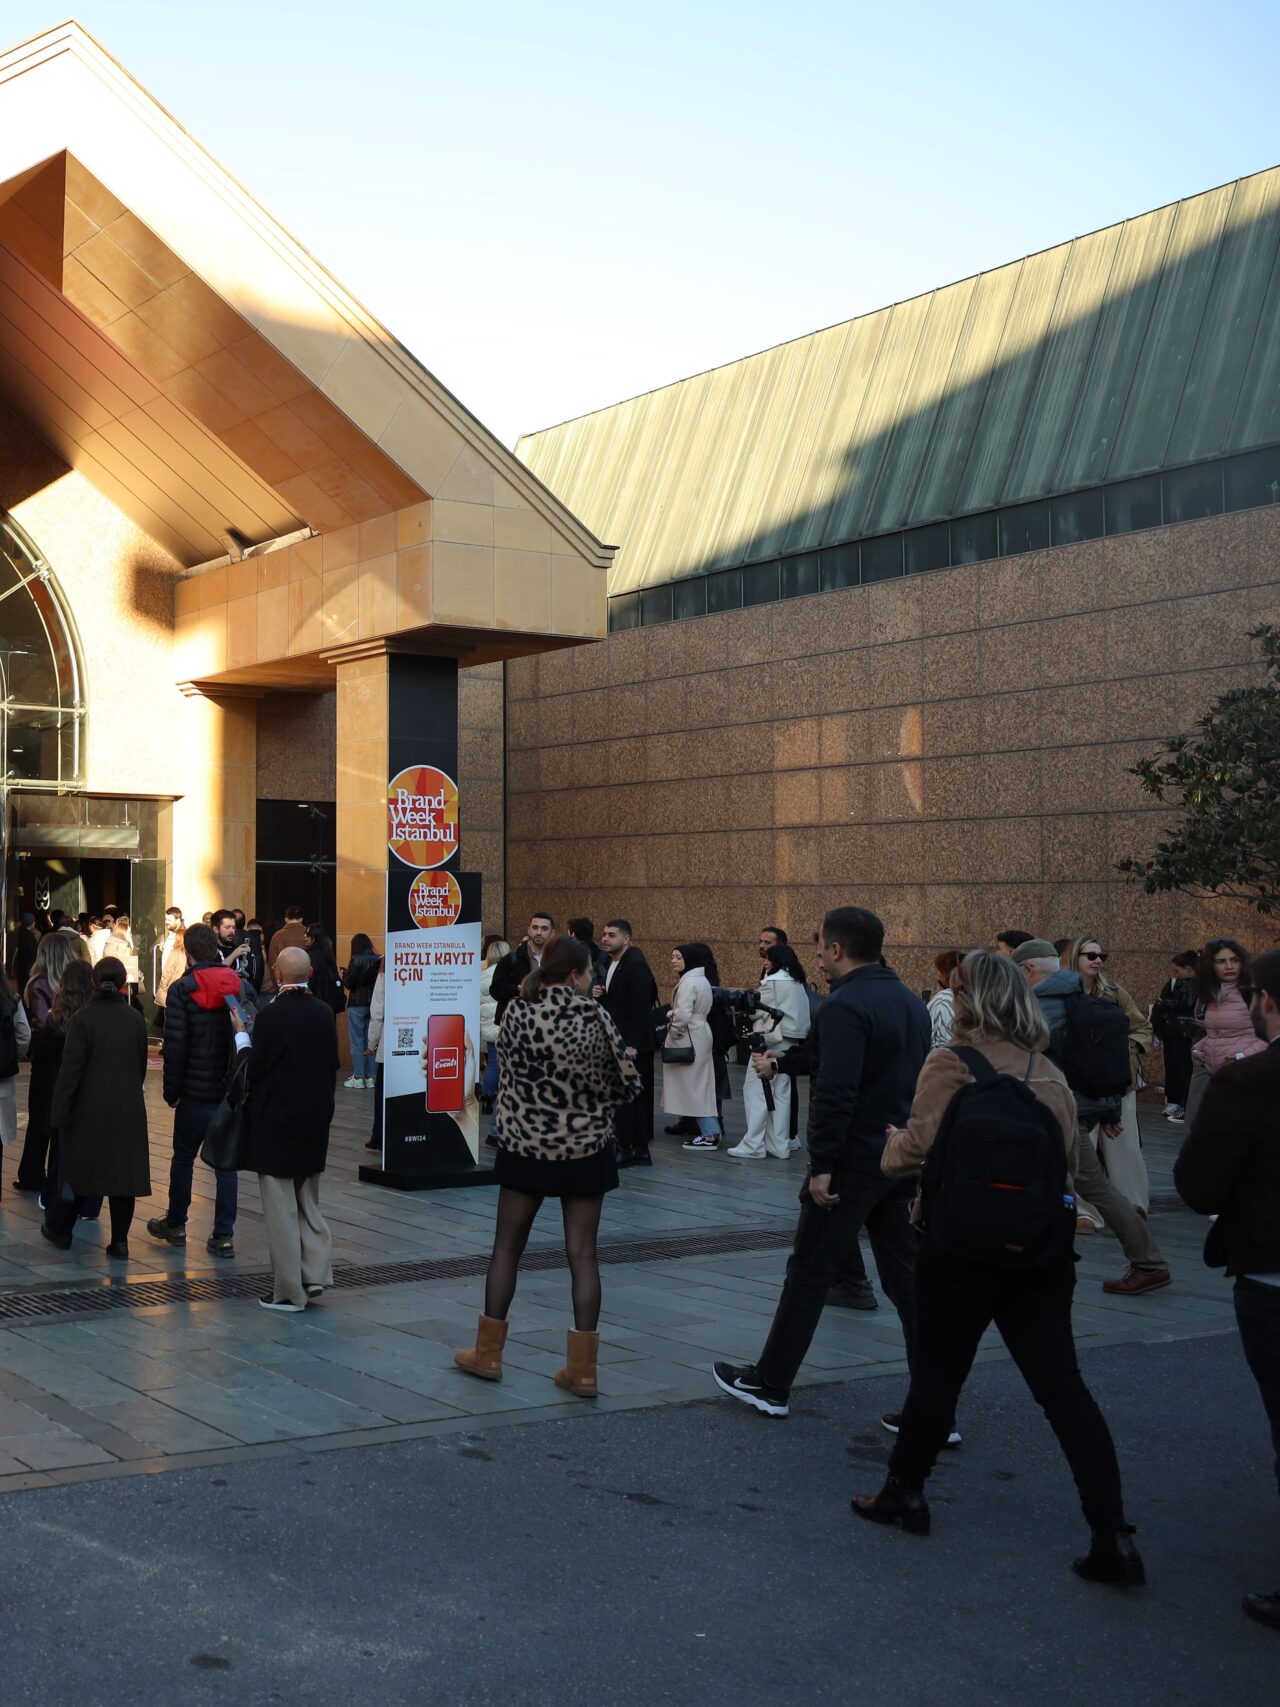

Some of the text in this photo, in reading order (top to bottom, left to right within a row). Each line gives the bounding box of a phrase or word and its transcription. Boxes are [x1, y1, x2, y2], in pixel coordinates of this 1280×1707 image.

[396, 788, 445, 809] Brand
[389, 804, 437, 825] Week
[391, 821, 455, 842] Istanbul
[418, 882, 449, 896] Brand
[414, 893, 444, 907] Week
[415, 903, 456, 917] Istanbul
[394, 952, 475, 966] HIZLI KAYIT
